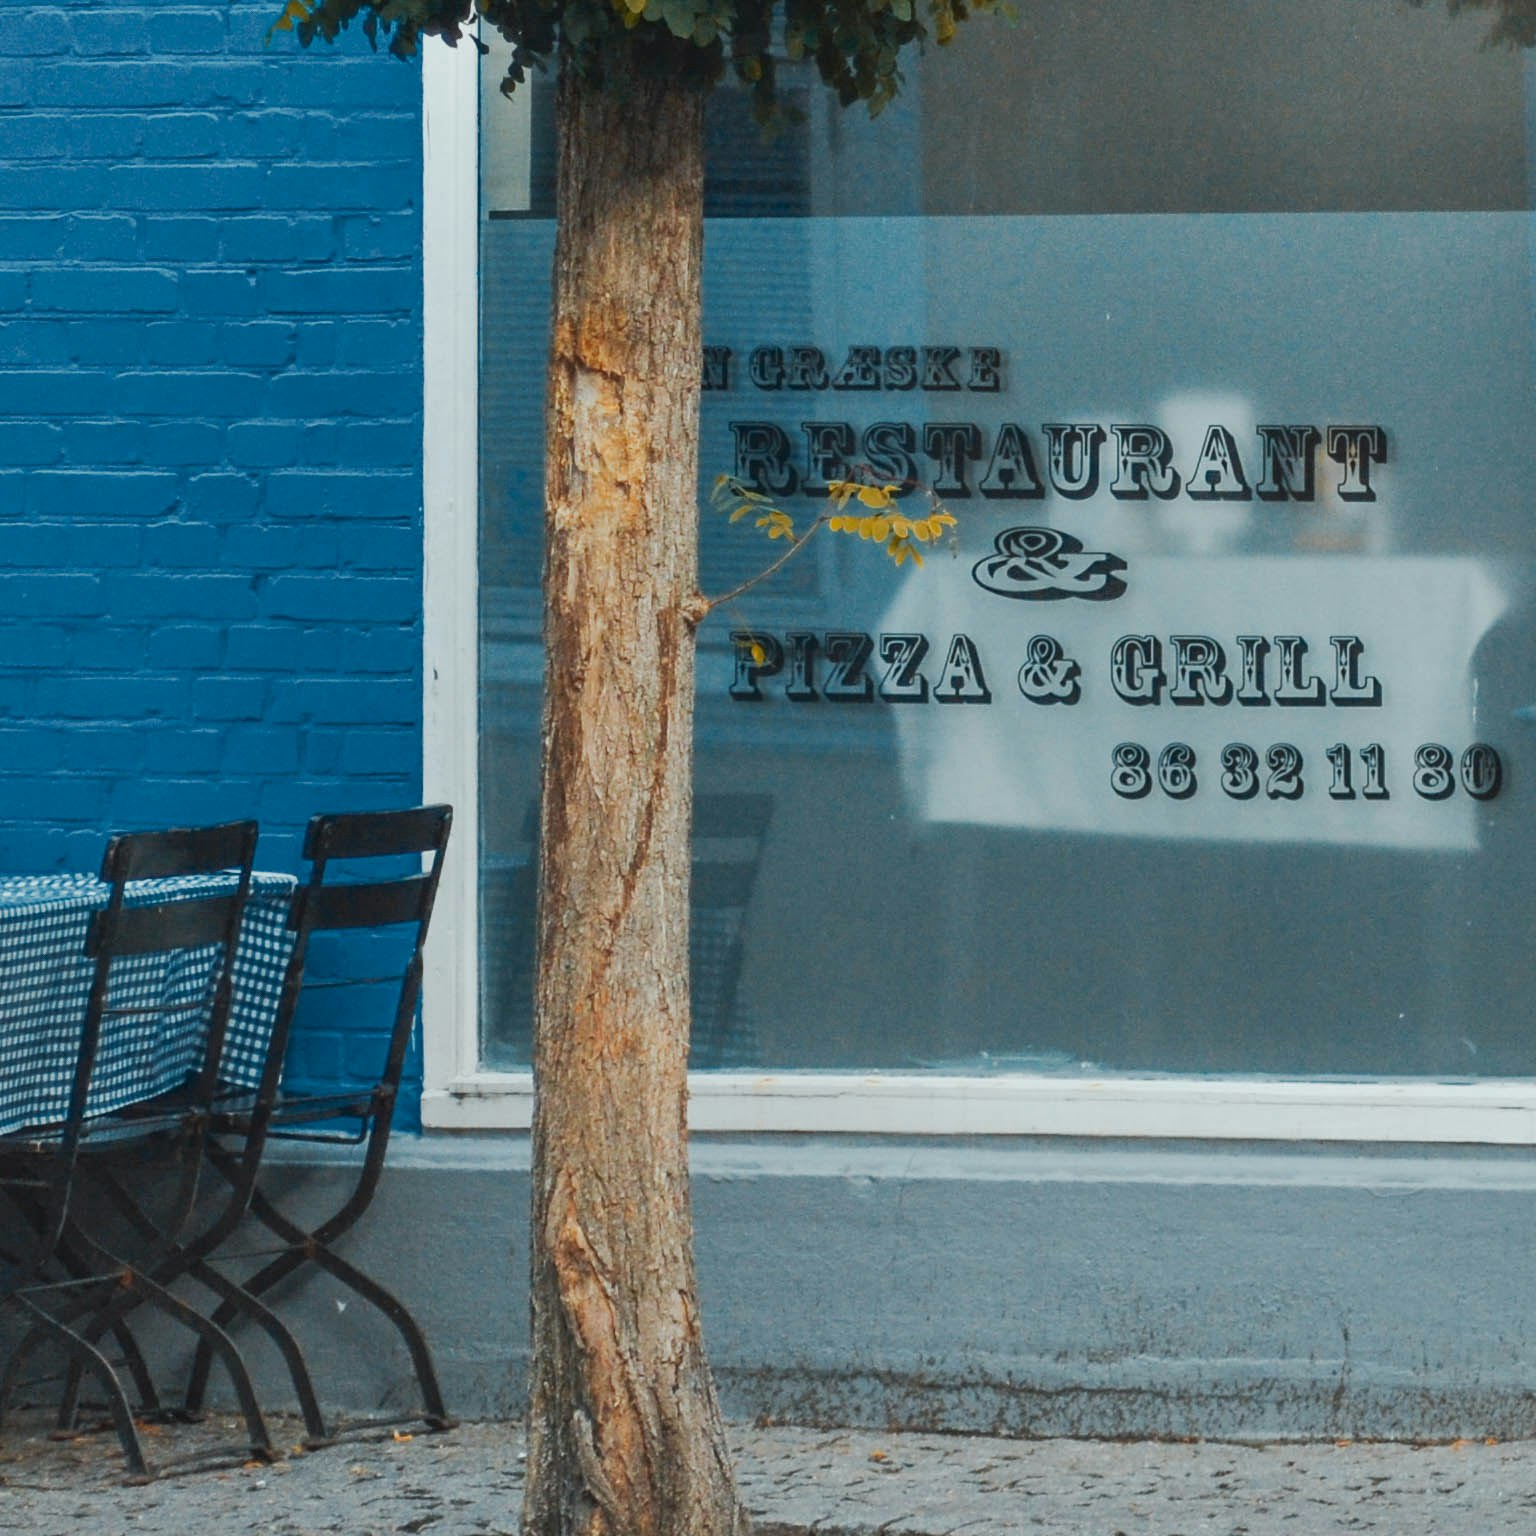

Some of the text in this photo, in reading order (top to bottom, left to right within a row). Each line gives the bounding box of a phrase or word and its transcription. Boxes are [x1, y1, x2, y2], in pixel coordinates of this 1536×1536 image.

[749, 345, 1003, 393] GRÆSKE
[729, 421, 1389, 503] RESTAURANT
[972, 526, 1127, 601] &
[729, 630, 1384, 707] PIZZA & GRILL
[1110, 741, 1502, 801] 86 32 11 80
